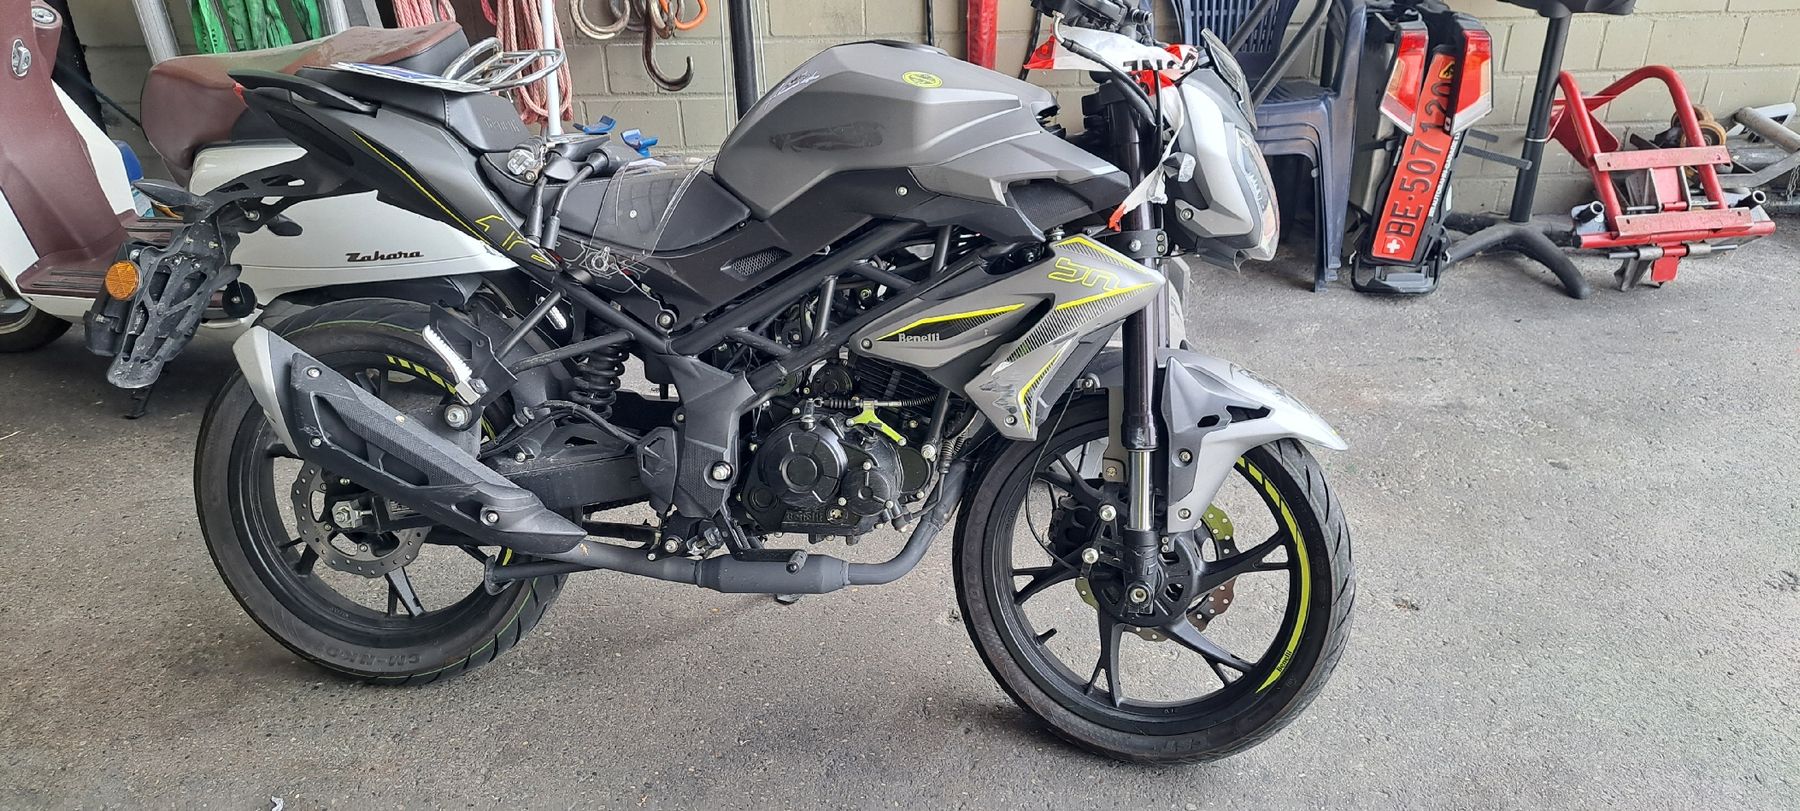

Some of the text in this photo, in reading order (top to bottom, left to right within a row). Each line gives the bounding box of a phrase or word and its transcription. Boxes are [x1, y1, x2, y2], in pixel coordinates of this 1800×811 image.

[345, 250, 424, 262] Zahara
[898, 332, 940, 343] Benelli
[1277, 650, 1293, 672] Benelli
